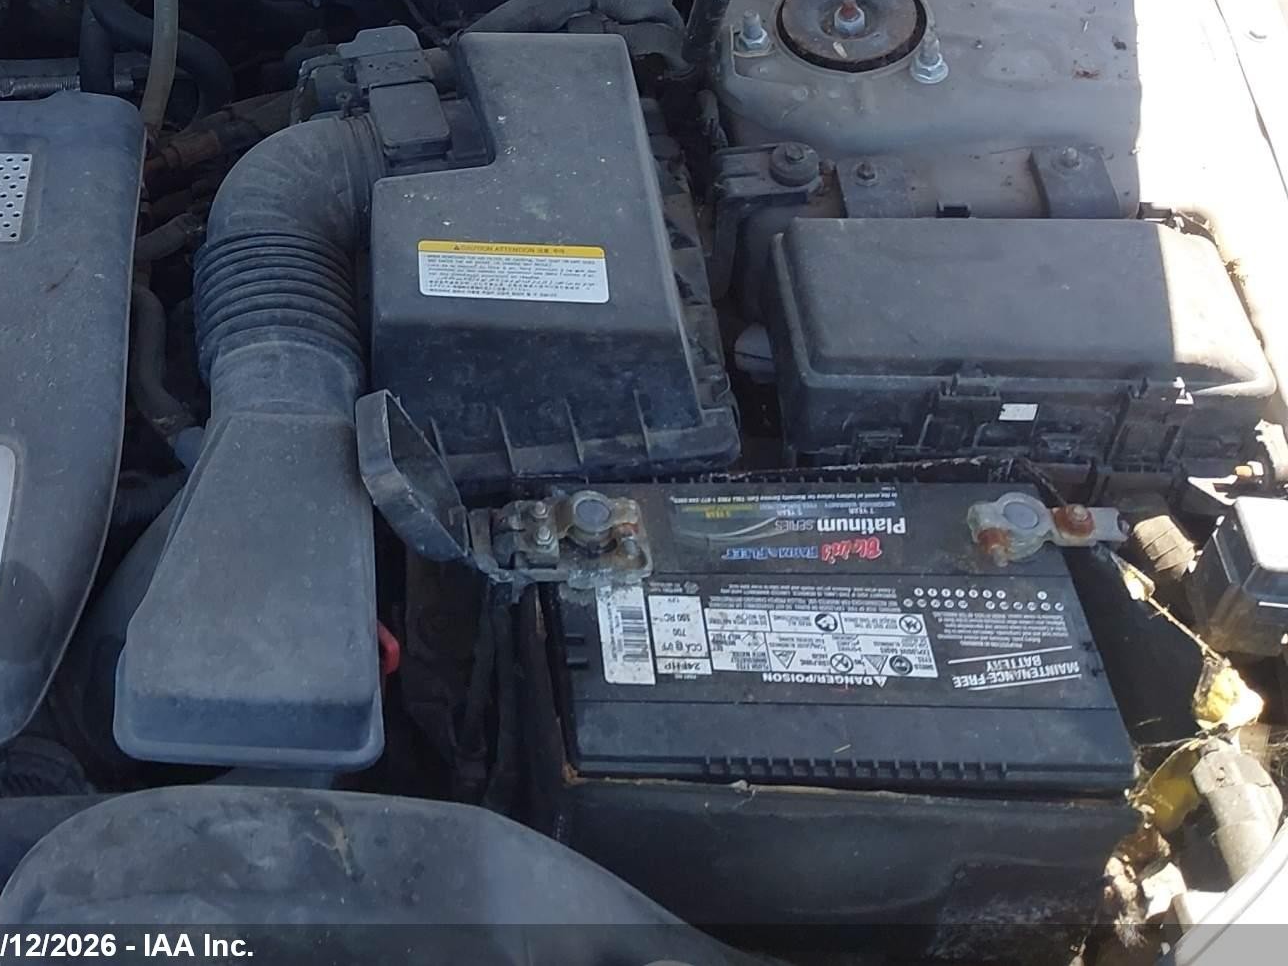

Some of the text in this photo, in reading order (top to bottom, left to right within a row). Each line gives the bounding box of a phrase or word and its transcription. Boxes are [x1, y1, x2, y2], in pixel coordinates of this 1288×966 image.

[774, 517, 907, 534] Platinum SERIES
[986, 655, 1042, 672] BATTERY
[762, 673, 874, 685] DANGER/POISON
[952, 661, 1080, 688] MAINTENANCE-FREE
